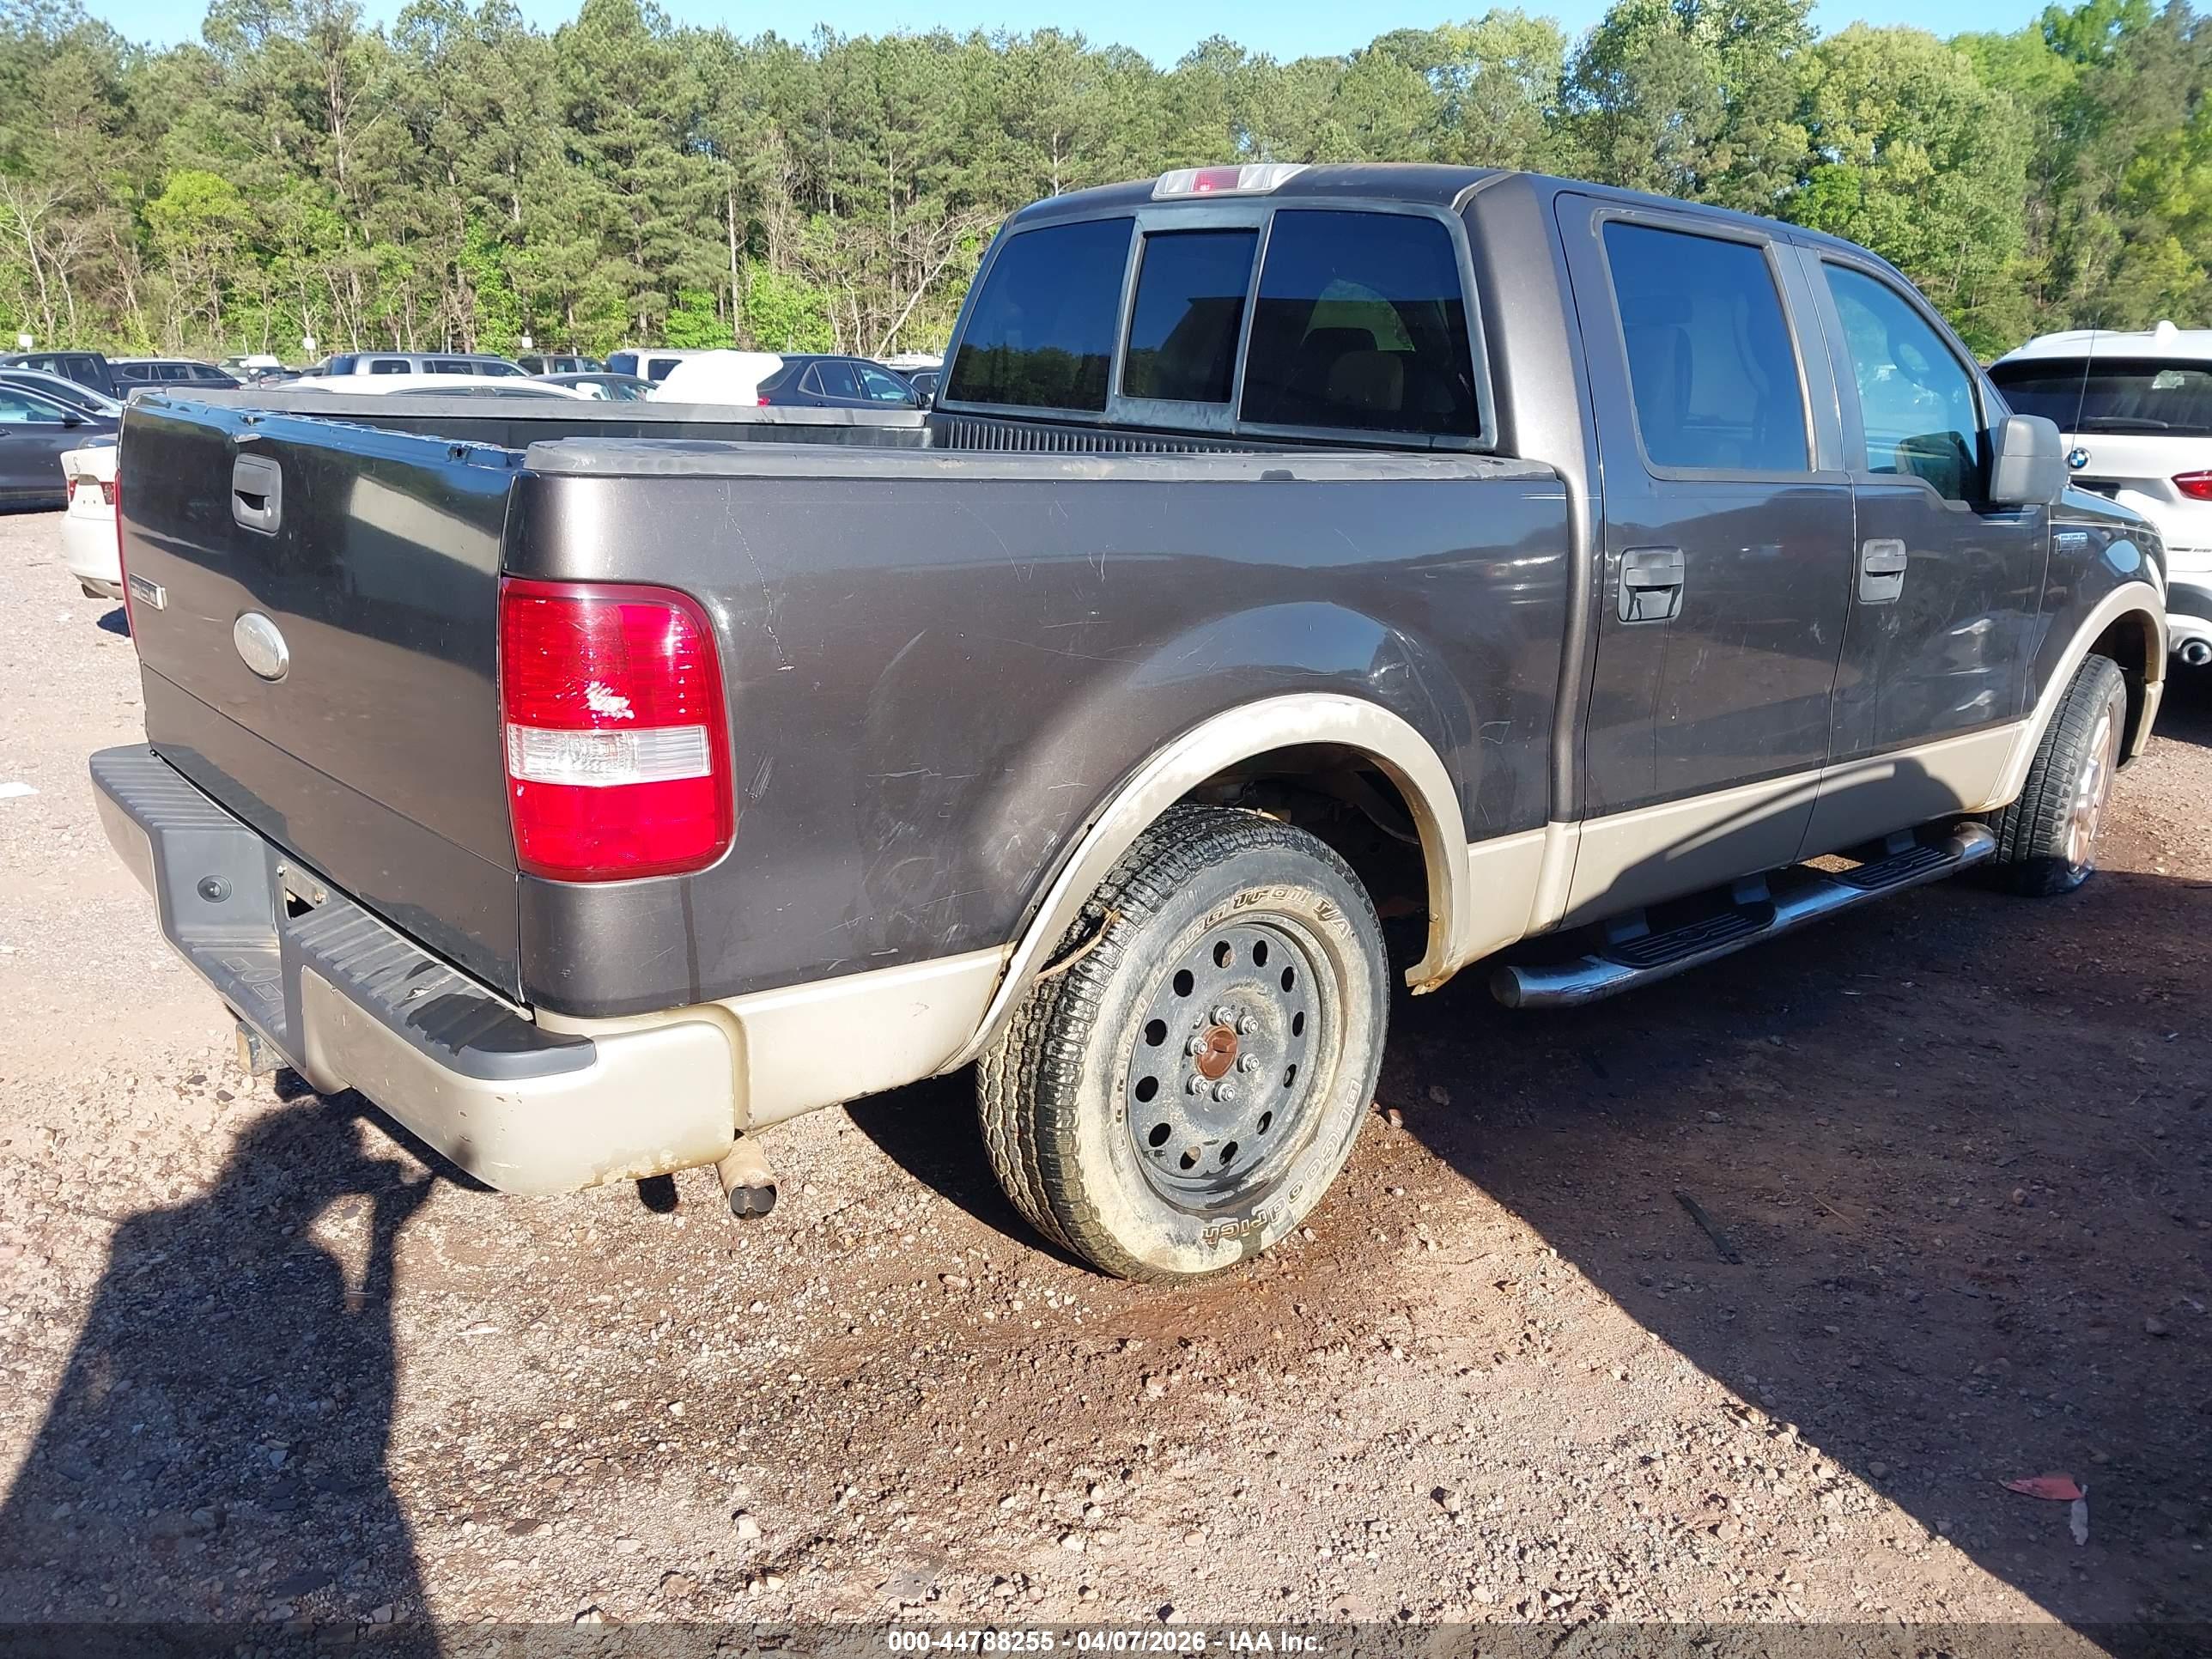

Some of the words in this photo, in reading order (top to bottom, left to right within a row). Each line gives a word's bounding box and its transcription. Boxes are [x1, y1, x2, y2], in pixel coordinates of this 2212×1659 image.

[1151, 904, 1226, 989] Long
[1233, 884, 1307, 910] Trail
[1311, 896, 1352, 940] T/A
[1201, 1080, 1360, 1247] BFGoodrich
